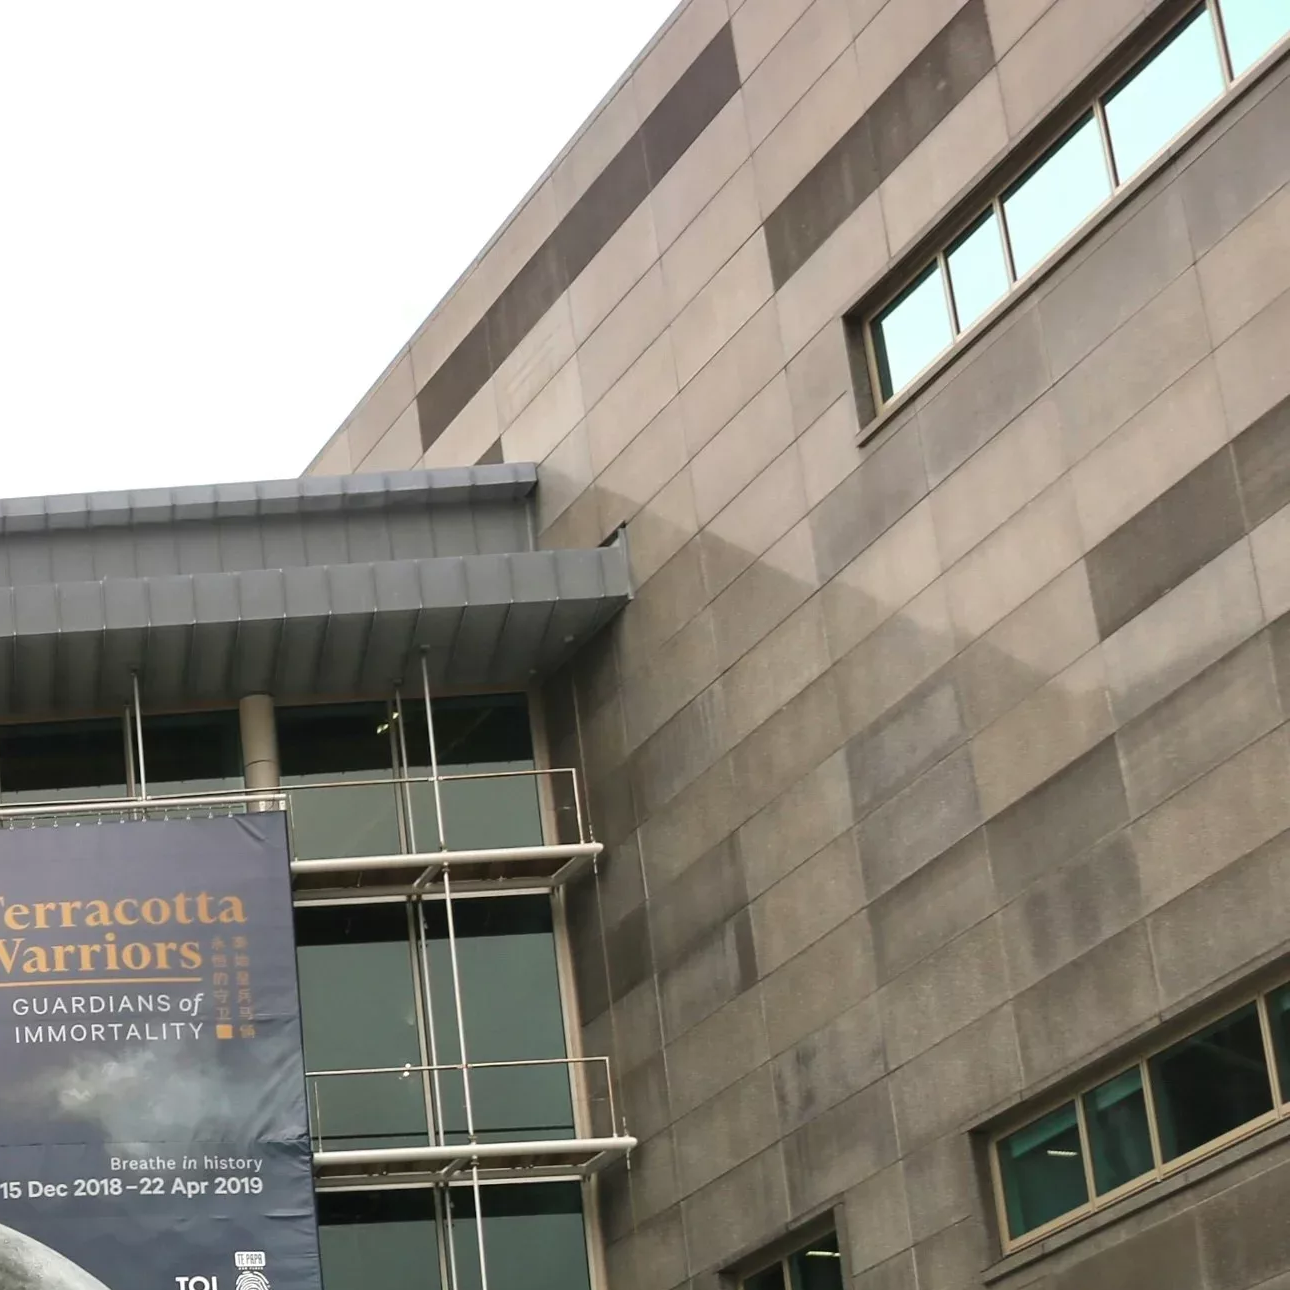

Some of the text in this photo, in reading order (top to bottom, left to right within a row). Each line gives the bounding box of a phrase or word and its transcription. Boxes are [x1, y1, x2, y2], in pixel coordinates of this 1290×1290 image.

[12, 993, 205, 1017] GUARDIANS of
[15, 1022, 204, 1044] IMMORTALITY
[110, 1155, 264, 1173] Breathe in history
[0, 1181, 23, 1199] 15
[27, 1180, 68, 1198] Dec
[170, 1176, 210, 1199] Apr
[214, 1176, 264, 1195] 2019
